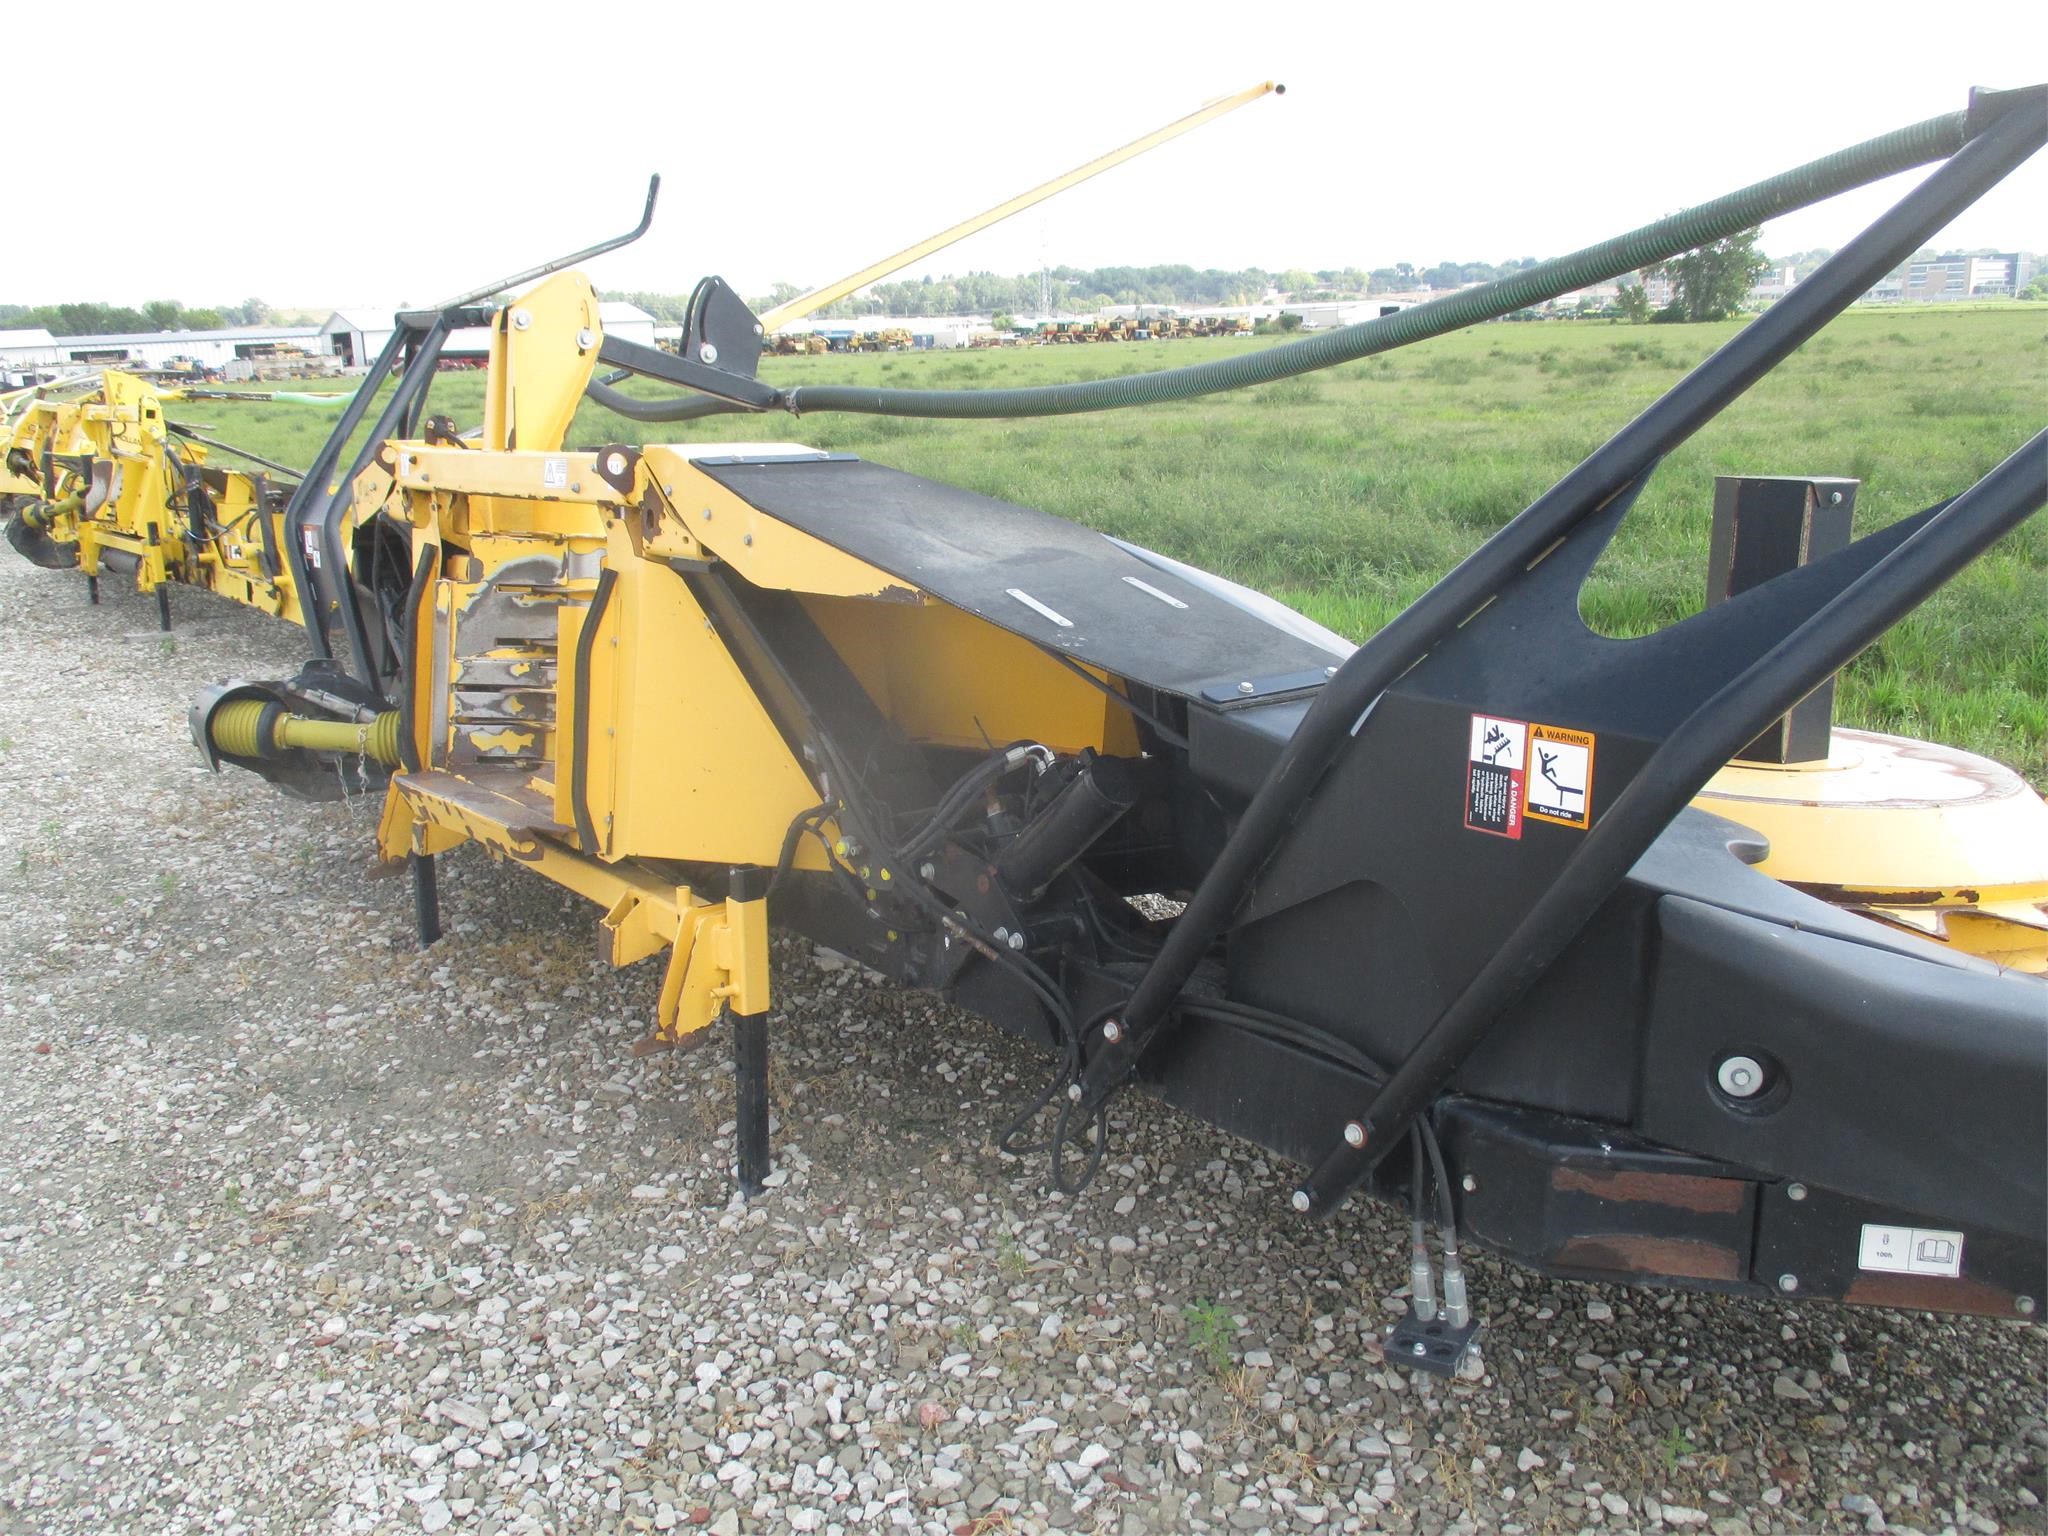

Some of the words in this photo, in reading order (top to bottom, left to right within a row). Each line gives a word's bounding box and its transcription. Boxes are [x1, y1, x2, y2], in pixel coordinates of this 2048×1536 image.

[1547, 730, 1590, 745] WARNING
[1509, 791, 1517, 826] DANGER
[1539, 806, 1549, 814] Do
[1560, 810, 1572, 819] ride
